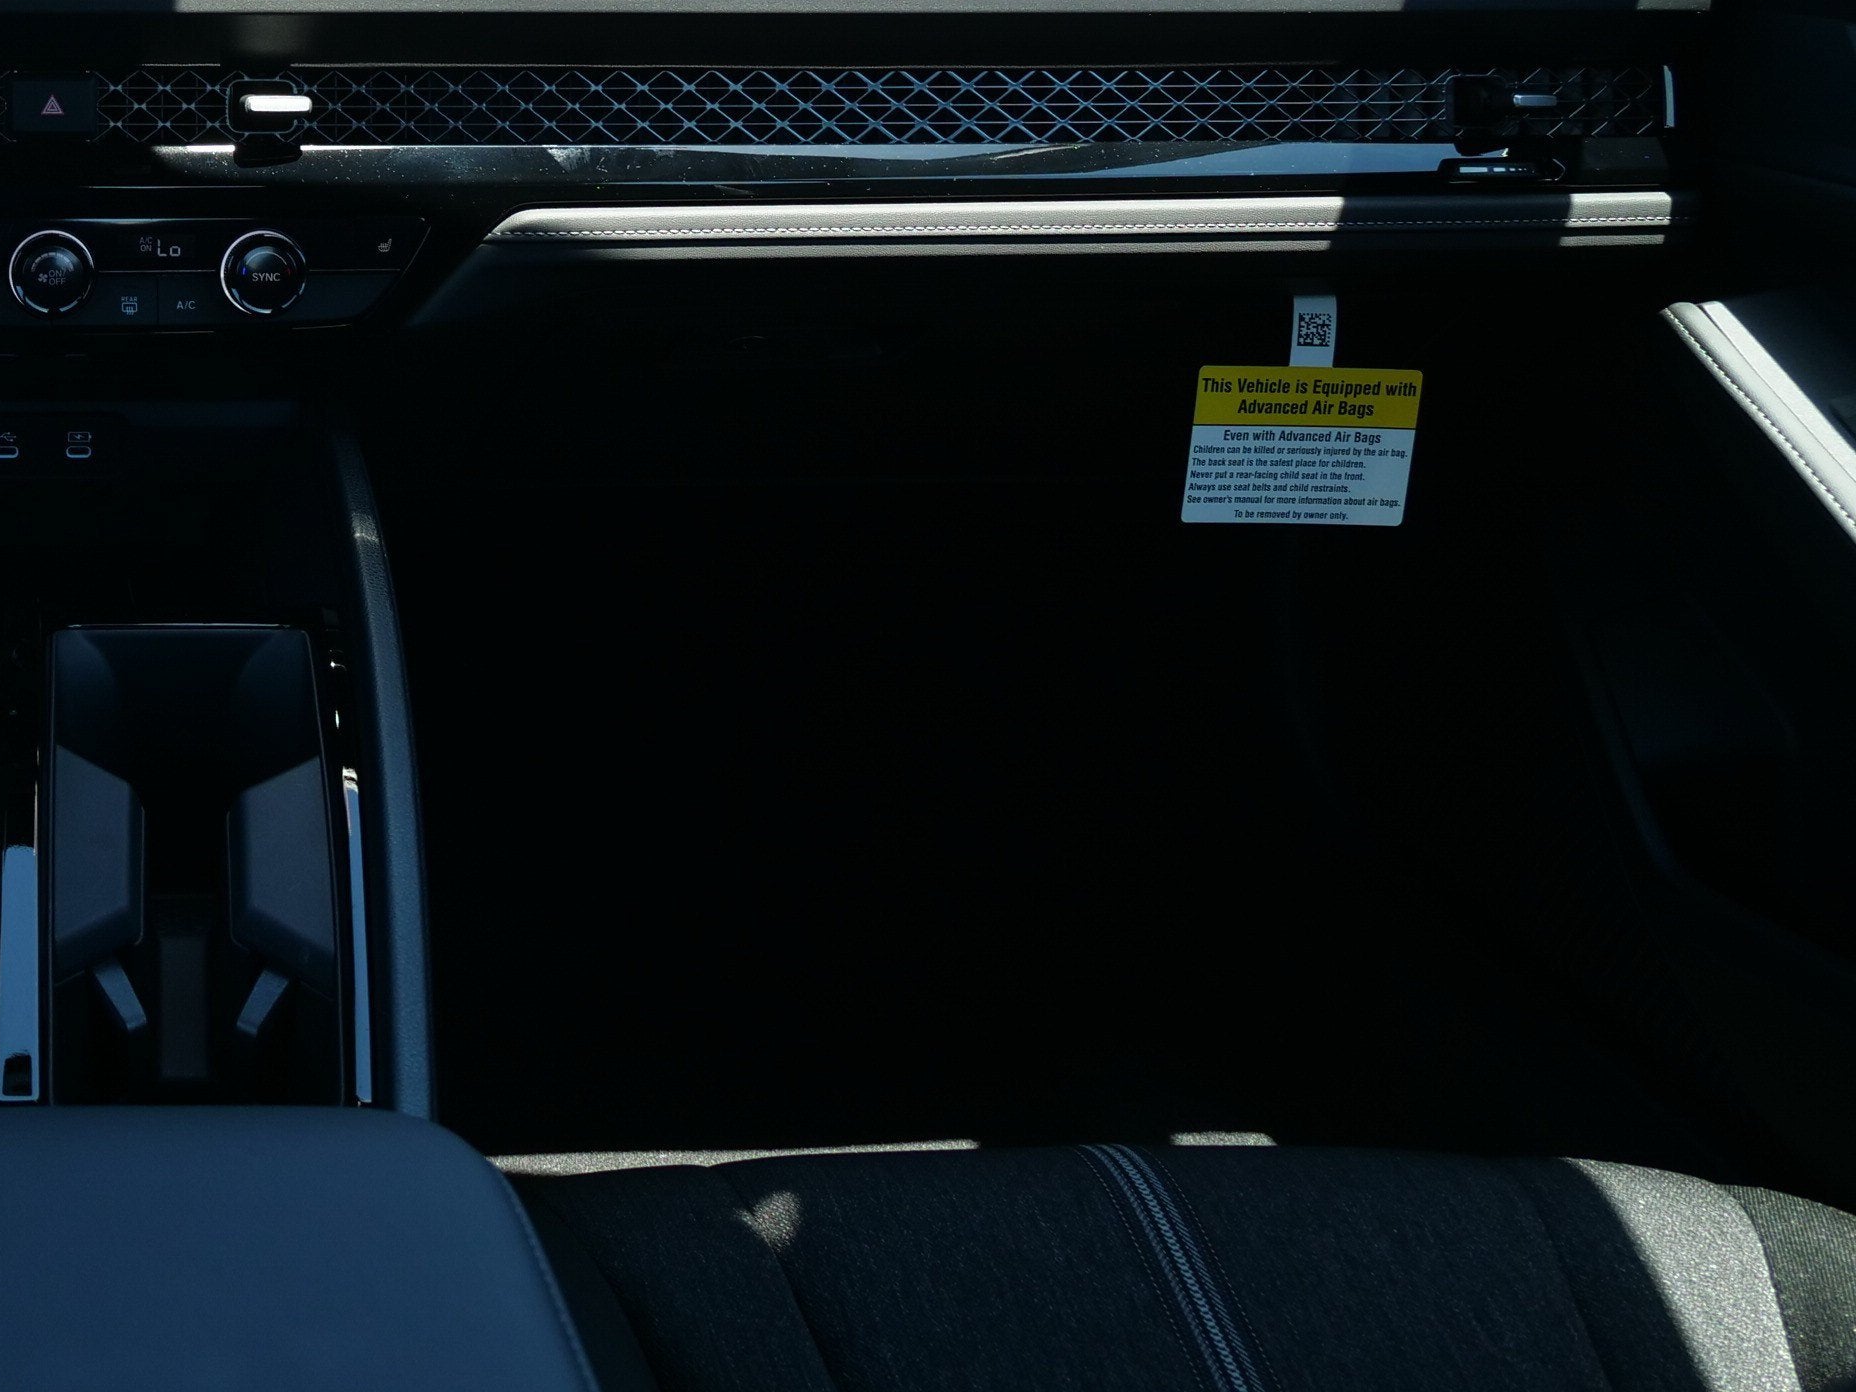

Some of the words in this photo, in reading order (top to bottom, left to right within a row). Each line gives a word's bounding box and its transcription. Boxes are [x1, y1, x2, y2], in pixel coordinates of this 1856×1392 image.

[139, 237, 152, 245] A/C
[140, 244, 152, 252] ON
[48, 277, 67, 286] OFF
[252, 272, 281, 282] SYNC
[176, 301, 196, 310] A/C
[1202, 378, 1232, 393] This
[1237, 378, 1290, 394] Vehicle
[1295, 379, 1308, 394] is
[1313, 379, 1381, 398] Equipped
[1386, 382, 1417, 397] with
[1237, 399, 1308, 414] Advanced
[1312, 400, 1334, 415] Air
[1338, 401, 1374, 419] Bags
[1223, 430, 1249, 441] Even
[1252, 430, 1275, 441] with
[1278, 430, 1332, 442] Advanced
[1334, 431, 1351, 443] Air
[1354, 432, 1382, 445] Bags
[1193, 445, 1225, 454] Children
[1227, 446, 1240, 454] can
[1242, 445, 1252, 454] be
[1253, 445, 1275, 454] killed
[1286, 446, 1321, 456] seriously
[1323, 446, 1351, 456] injured
[1353, 447, 1361, 457] by
[1363, 447, 1376, 456] the
[1378, 448, 1389, 457] air
[1391, 448, 1408, 458] bag.
[1192, 458, 1205, 466] The
[1208, 458, 1226, 466] back
[1228, 458, 1245, 466] seat
[1246, 458, 1254, 466] is
[1255, 458, 1268, 466] the
[1269, 458, 1293, 467] safest
[1295, 458, 1317, 468] place
[1318, 459, 1330, 467] for
[1331, 459, 1366, 468] children.
[1190, 470, 1213, 479] Never
[1214, 470, 1227, 480] put
[1236, 470, 1278, 480] rear-facing
[1280, 471, 1299, 479] child
[1301, 471, 1318, 480] seat
[1320, 471, 1328, 480] in
[1329, 472, 1342, 480] the
[1344, 472, 1365, 481] front.
[1188, 483, 1216, 492] Always
[1233, 483, 1250, 491] seat
[1251, 483, 1271, 491] belts
[1272, 483, 1287, 491] and
[1289, 484, 1309, 492] child
[1310, 484, 1351, 493] restraints.
[1186, 494, 1201, 503] See
[1203, 495, 1232, 503] owner's
[1234, 495, 1262, 503] manual
[1264, 495, 1275, 503] for
[1276, 496, 1296, 504] more
[1298, 495, 1342, 505] information
[1343, 497, 1365, 505] about
[1366, 497, 1378, 506] air
[1380, 498, 1401, 508] bags.
[1234, 509, 1243, 518] To
[1244, 509, 1254, 518] be
[1256, 509, 1291, 519] removed
[1292, 510, 1302, 520] by
[1303, 511, 1328, 519] owner
[1329, 511, 1348, 521] only.
